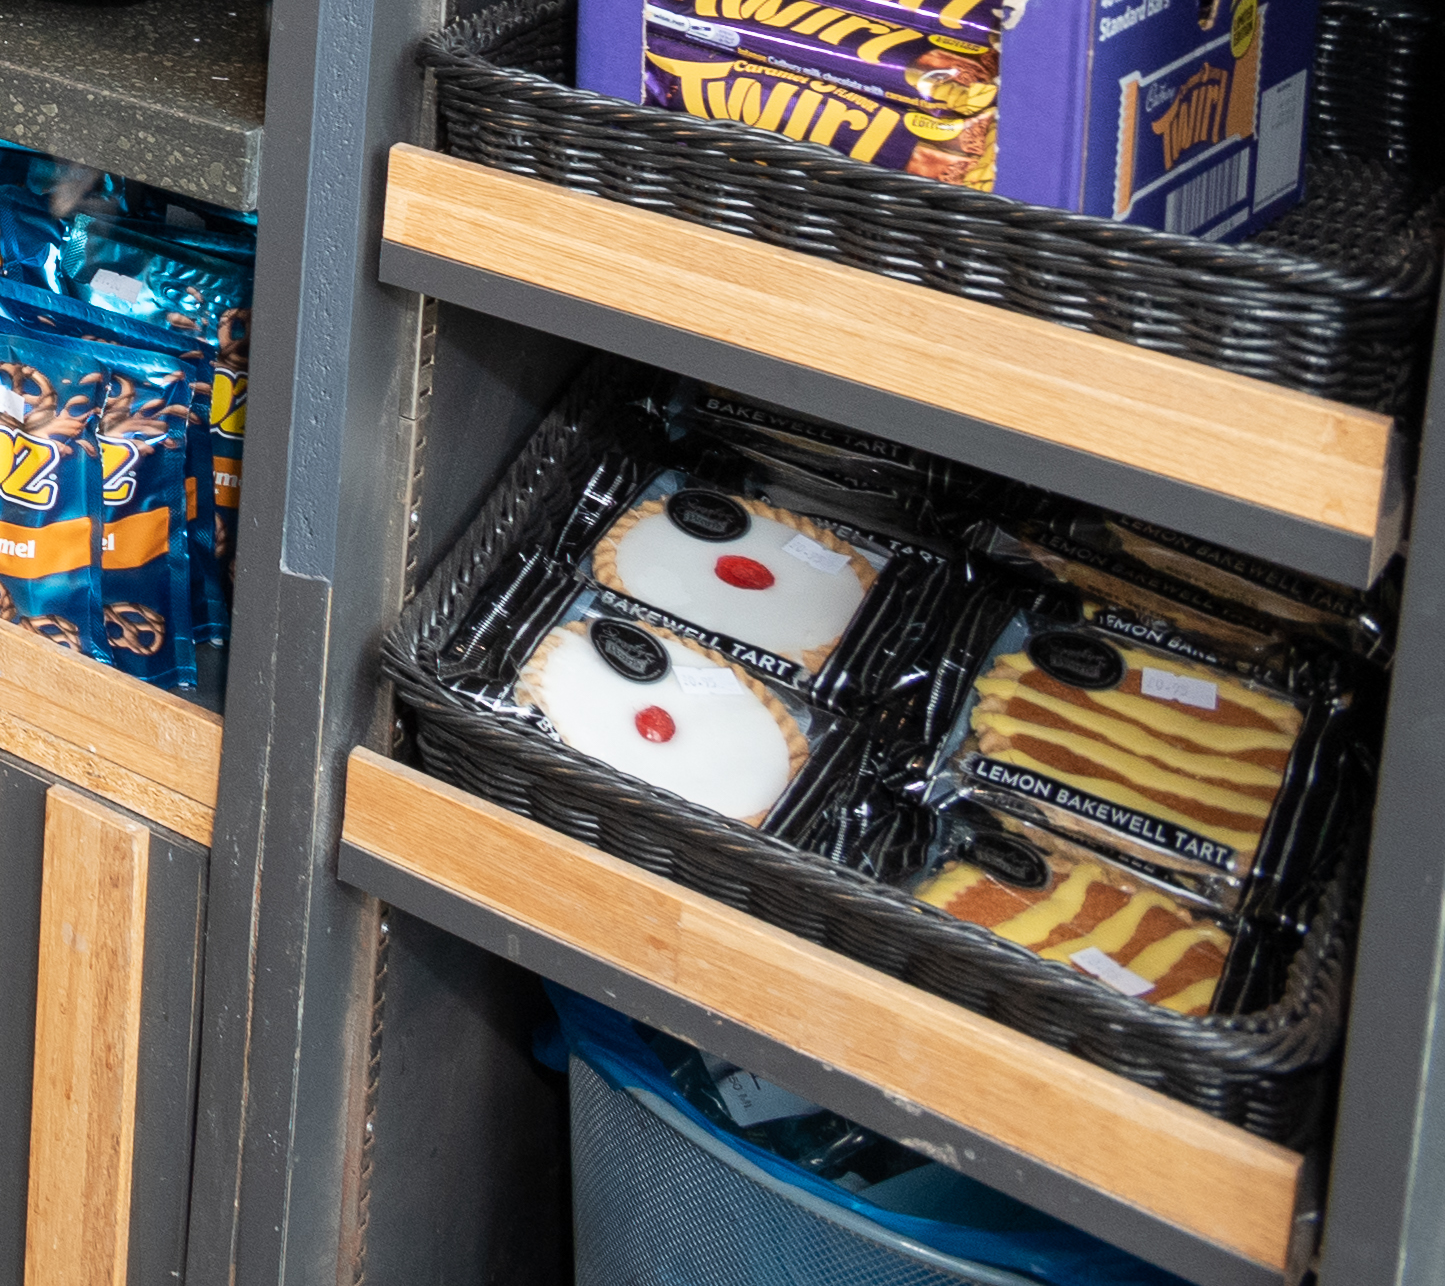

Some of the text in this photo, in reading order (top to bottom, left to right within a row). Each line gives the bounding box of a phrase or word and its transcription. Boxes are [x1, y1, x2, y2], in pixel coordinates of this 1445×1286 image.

[601, 590, 794, 679] BAKEWELL TART
[975, 760, 1229, 865] LEMON BAKEWELL TART
